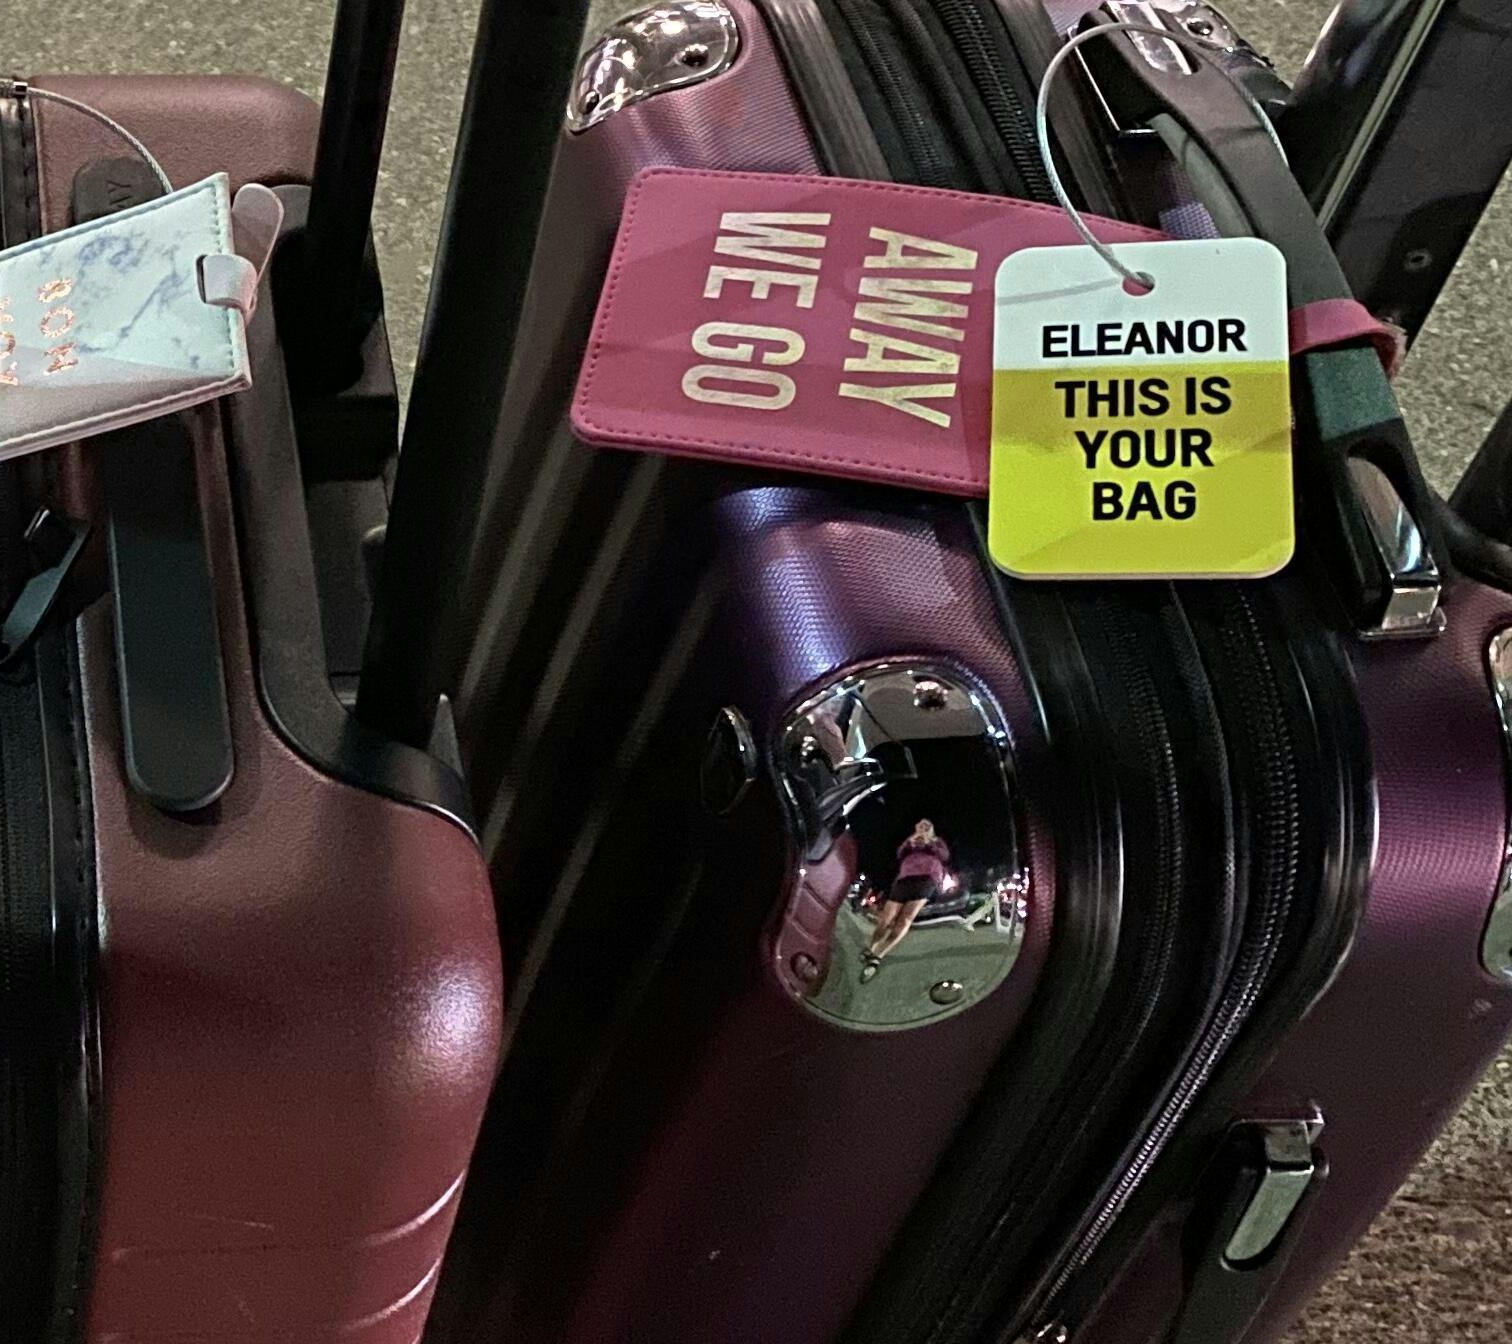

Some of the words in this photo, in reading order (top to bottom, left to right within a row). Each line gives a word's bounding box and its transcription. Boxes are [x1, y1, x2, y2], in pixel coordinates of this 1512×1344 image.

[702, 212, 832, 308] WE
[838, 226, 979, 428] AWAY
[1042, 318, 1248, 358] ELEANOR
[681, 321, 806, 410] GO
[1054, 378, 1170, 418] THIS
[1185, 376, 1232, 415] IS
[1074, 428, 1215, 469] YOUR
[1092, 480, 1197, 521] BAG
